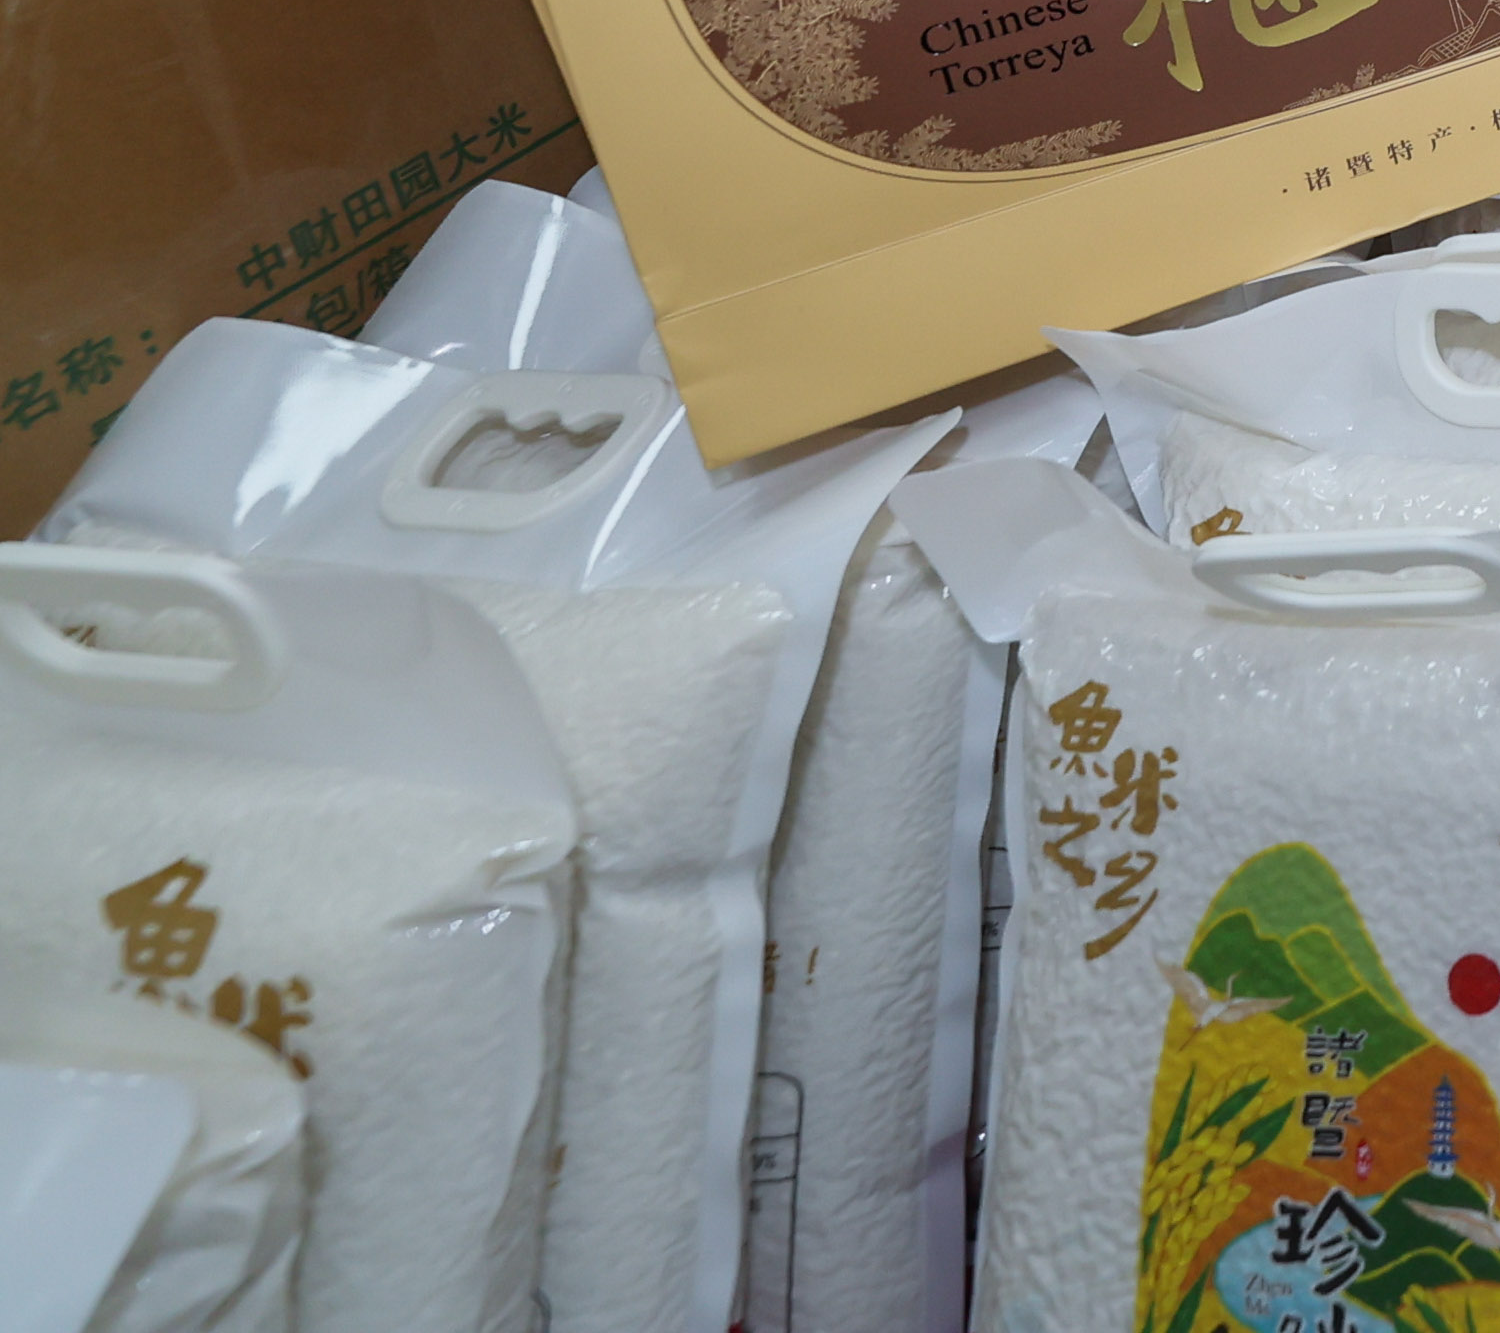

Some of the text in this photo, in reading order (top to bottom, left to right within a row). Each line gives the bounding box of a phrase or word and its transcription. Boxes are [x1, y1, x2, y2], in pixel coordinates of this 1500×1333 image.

[931, 34, 1097, 99] Torreya
[237, 101, 533, 293] 中财田园大米
